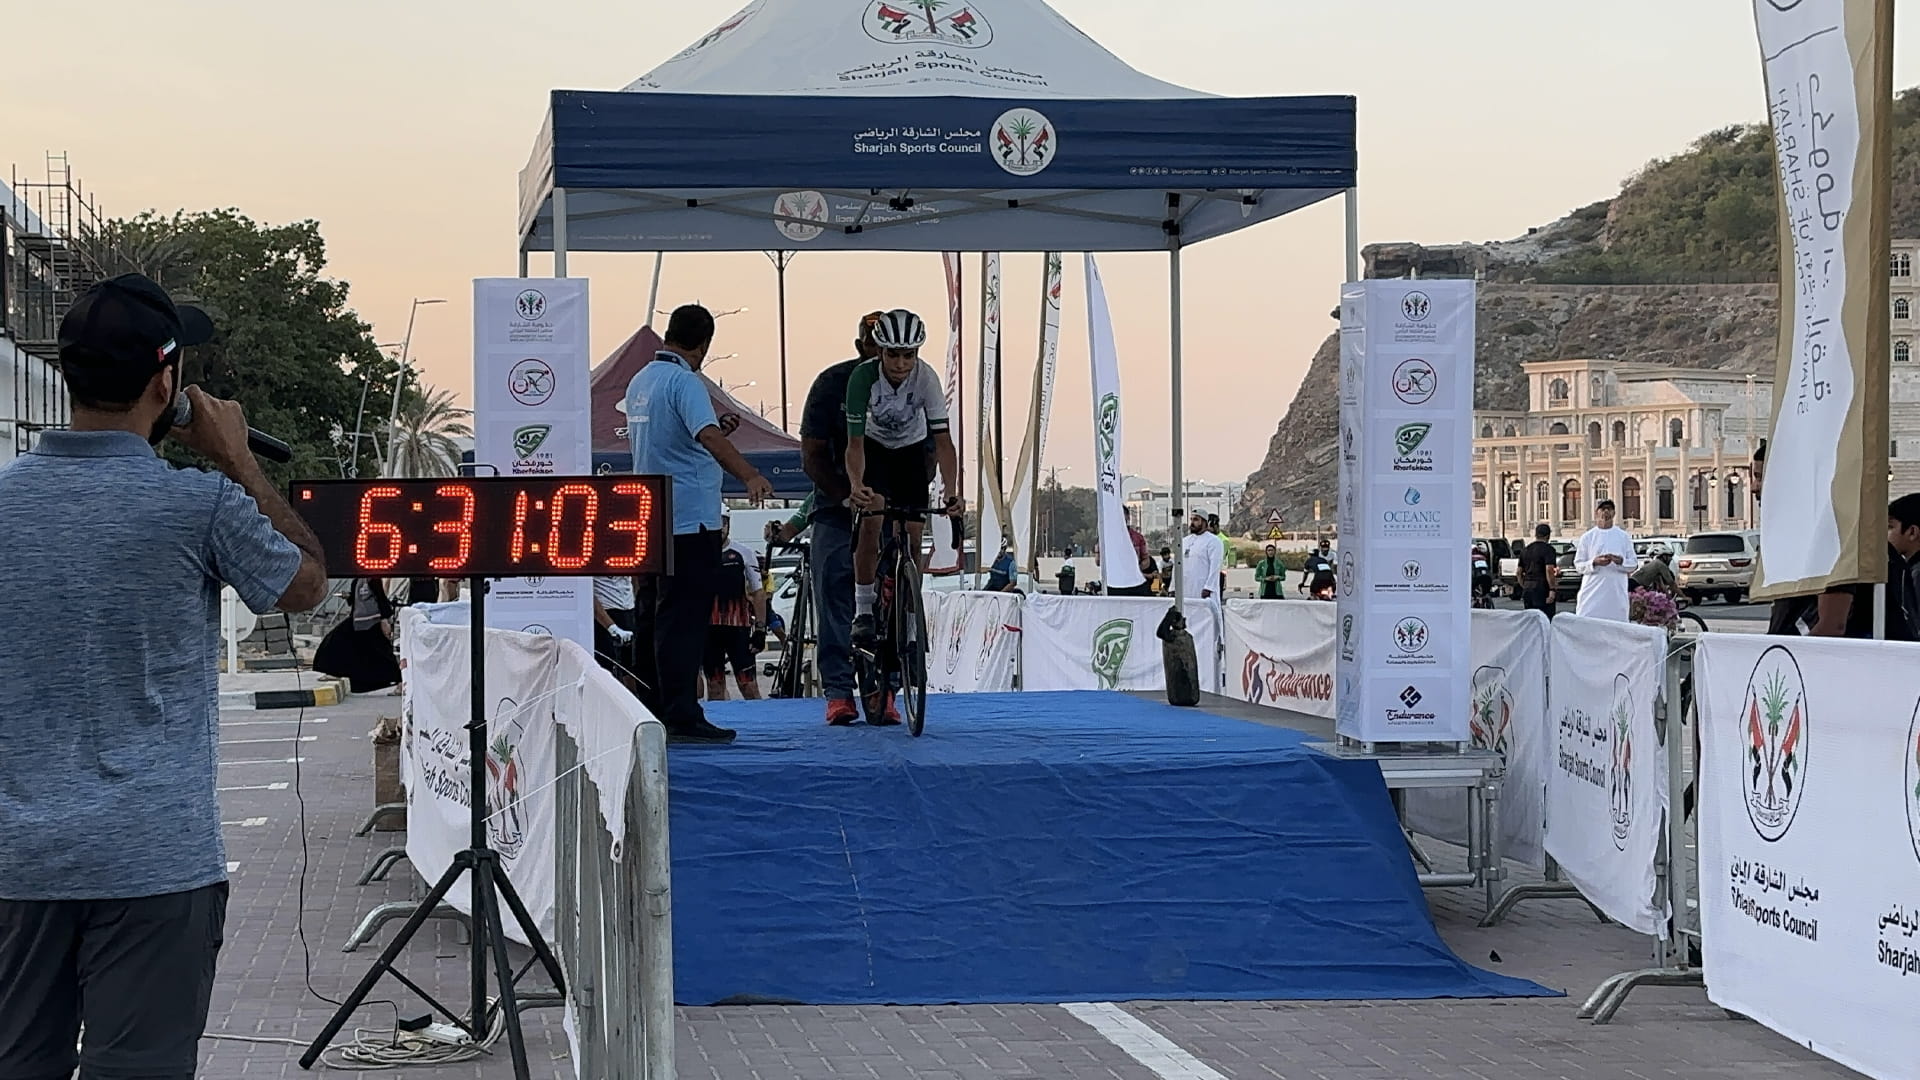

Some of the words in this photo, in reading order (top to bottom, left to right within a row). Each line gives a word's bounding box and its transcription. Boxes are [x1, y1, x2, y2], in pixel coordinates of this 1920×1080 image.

[838, 66, 909, 81] Sharjah
[914, 61, 975, 73] Sports
[979, 70, 1049, 87] Council
[854, 127, 899, 140] الرياضي
[901, 127, 941, 140] الشارقة
[944, 129, 981, 140] مجلس
[854, 143, 897, 155] Sharjah
[899, 143, 936, 155] Sports
[939, 143, 982, 153] Council
[1383, 510, 1441, 523] OCEANIC
[1385, 708, 1436, 721] Endurance
[1753, 862, 1786, 893] الشارقة
[1787, 877, 1819, 908] مجلس
[1782, 909, 1818, 942] Council
[1878, 938, 1920, 977] Sharjah
